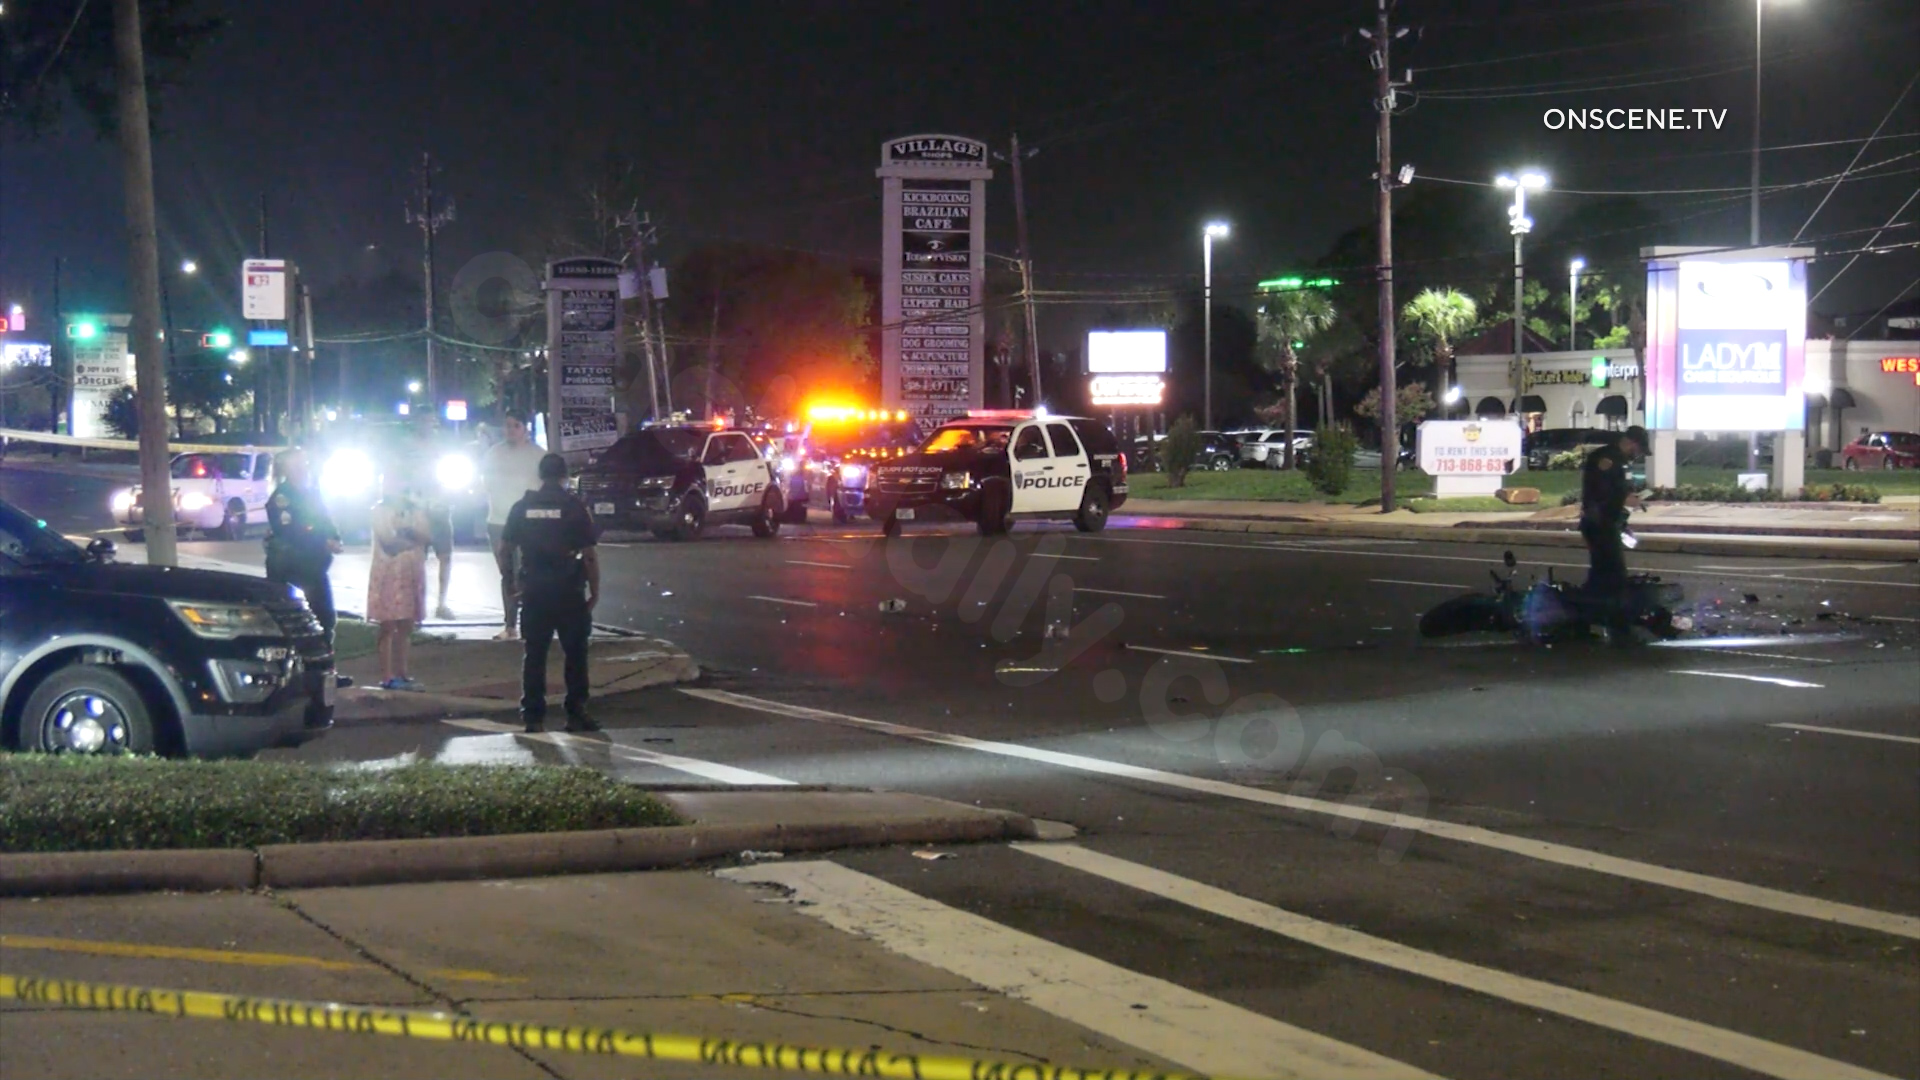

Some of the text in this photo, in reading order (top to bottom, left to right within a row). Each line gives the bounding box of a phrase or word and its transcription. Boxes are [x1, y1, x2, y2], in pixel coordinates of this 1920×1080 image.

[894, 139, 981, 157] VILLAGE
[903, 192, 970, 202] KICKBOXING
[903, 206, 969, 218] BRAZILIAN
[939, 272, 970, 282] CAKES
[904, 285, 969, 294] MAGIC NAILS
[903, 298, 969, 309] EXPERT HAIR
[902, 338, 969, 349] DOG GROOMING
[565, 366, 612, 374] TATTOO
[1881, 358, 1920, 372] WES
[565, 376, 613, 384] PIERCING
[923, 379, 969, 392] LOTUS
[1447, 446, 1467, 456] RENT
[1469, 446, 1487, 456] THIS
[1436, 458, 1508, 472] 713-868-63
[1023, 475, 1084, 489] POLICE
[713, 482, 764, 498] POLICE
